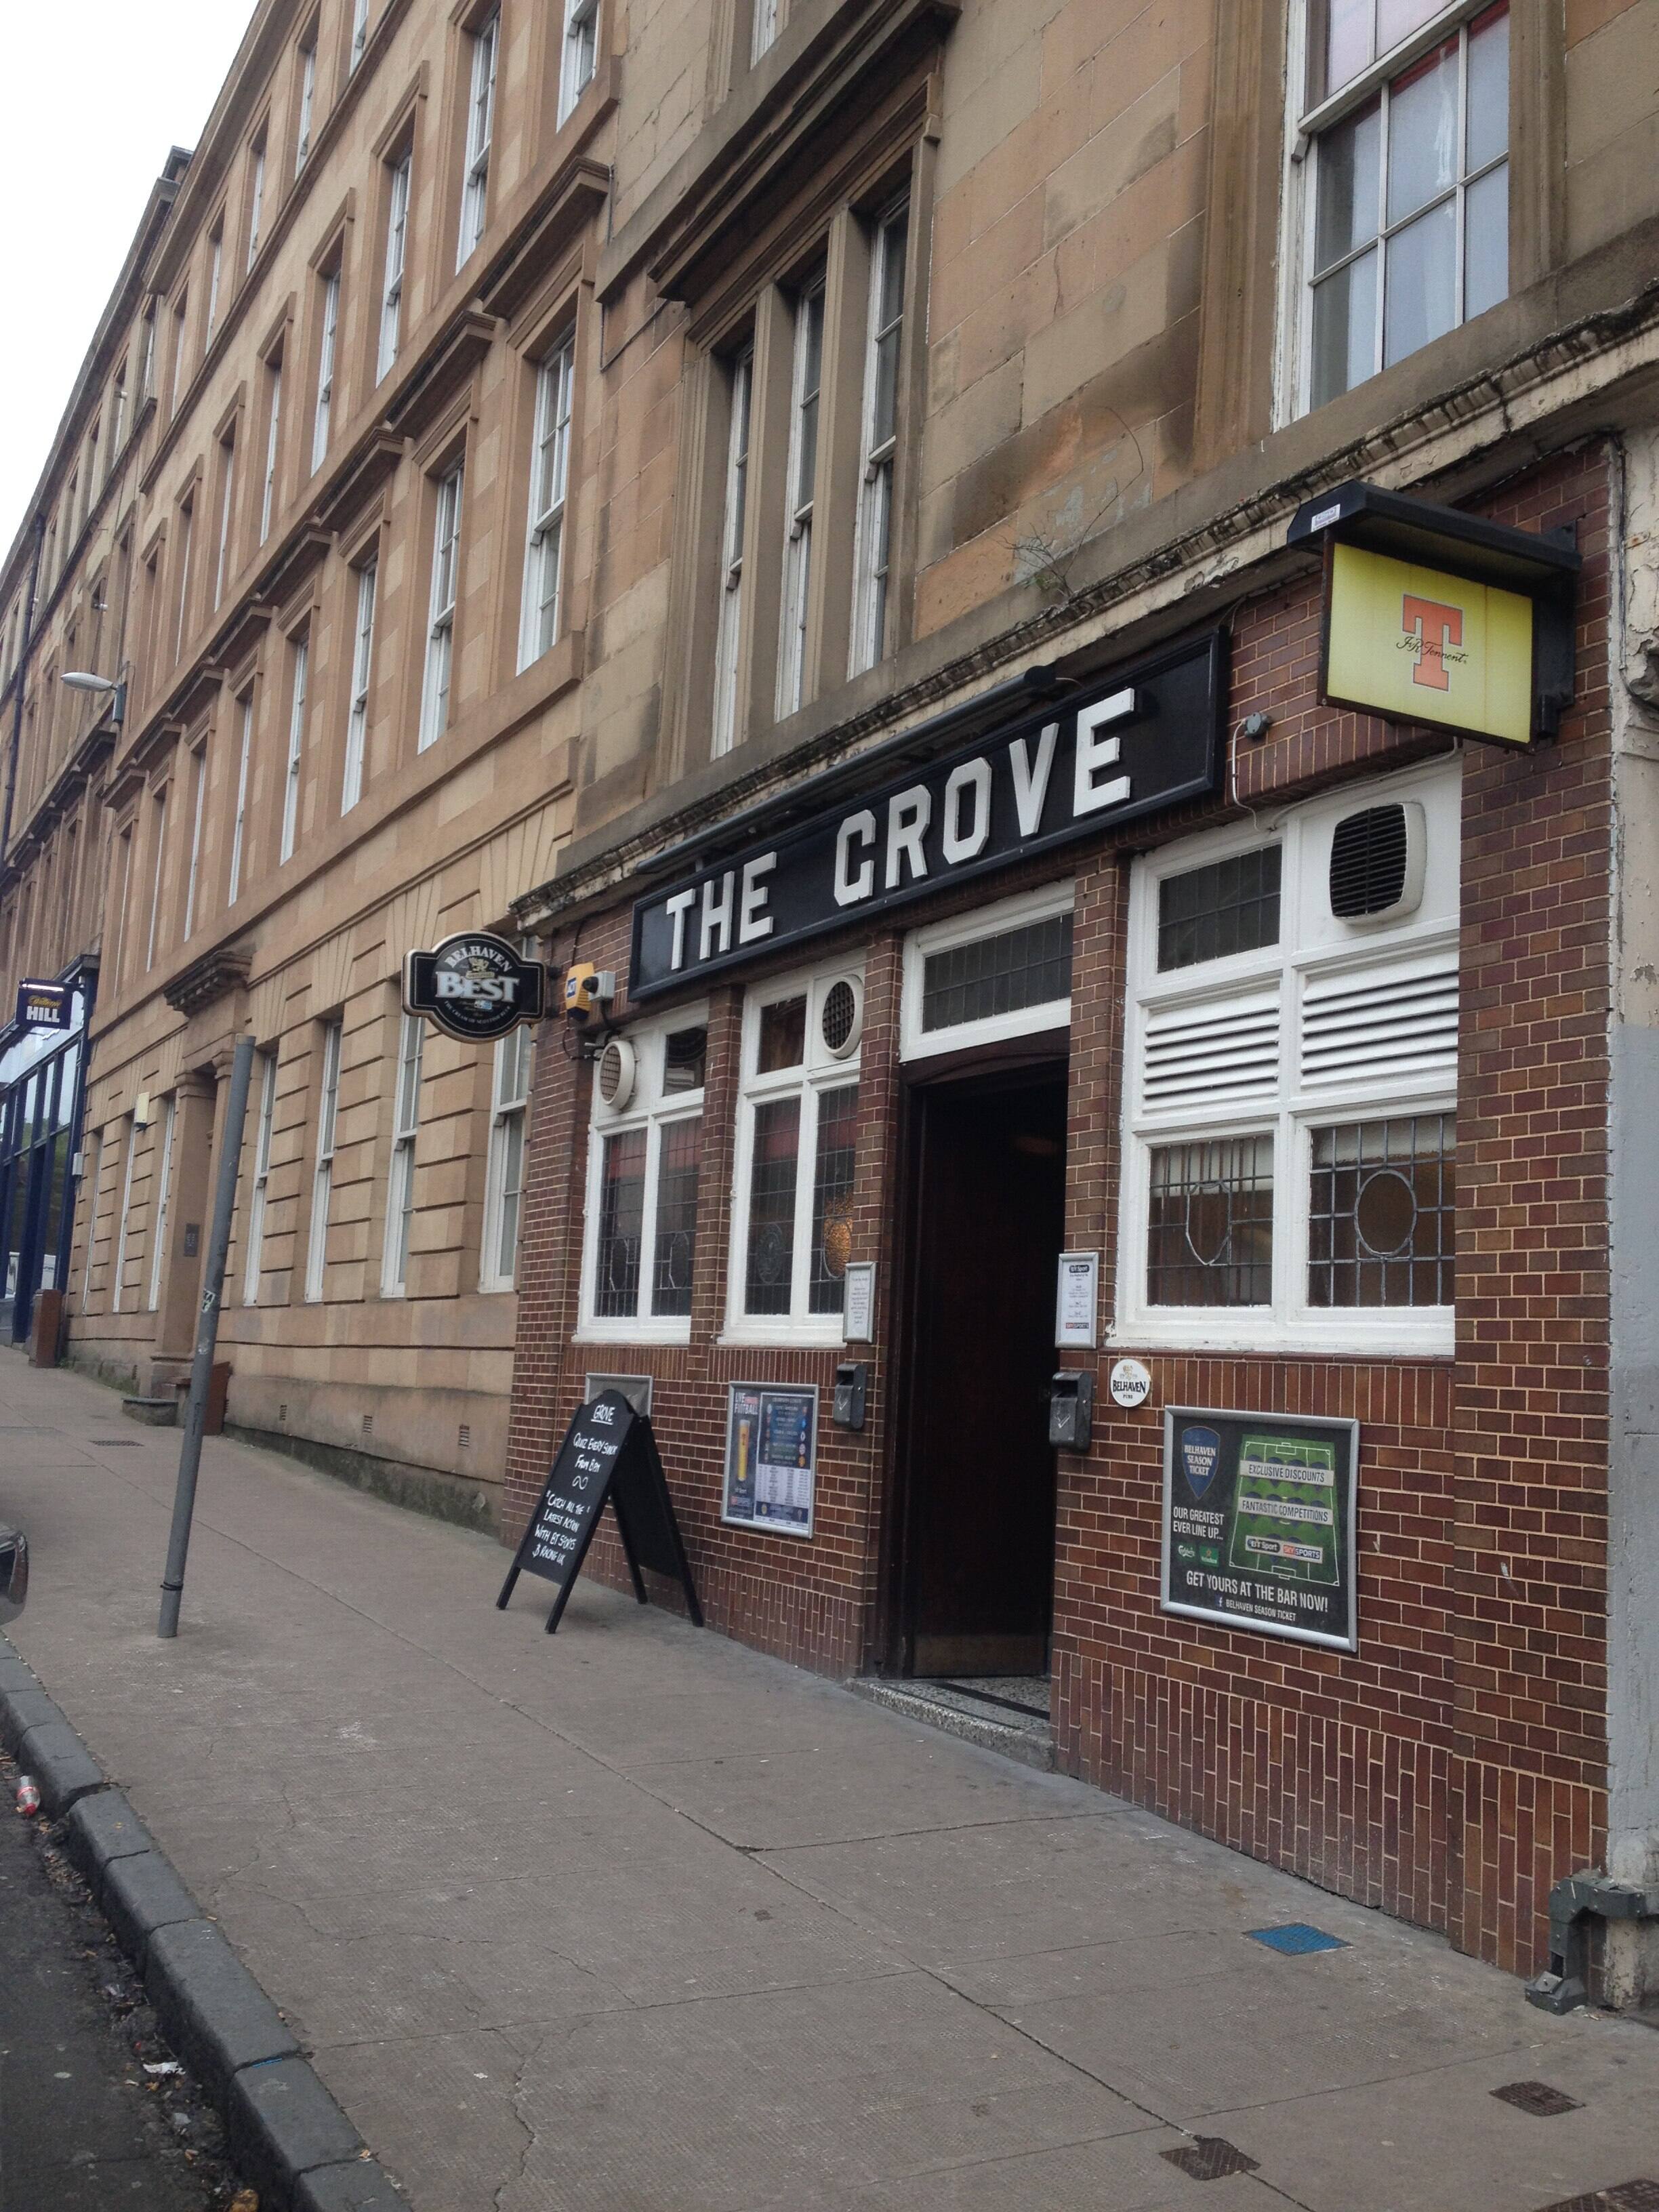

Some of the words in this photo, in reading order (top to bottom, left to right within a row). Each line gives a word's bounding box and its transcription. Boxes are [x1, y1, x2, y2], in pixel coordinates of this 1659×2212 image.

[666, 851, 777, 970] THE
[833, 687, 1135, 907] GROVE
[444, 945, 512, 972] BELHAVEN
[434, 970, 520, 1003] BEST
[26, 1005, 60, 1023] HILL
[1113, 1379, 1146, 1394] BELHAVEN
[593, 1404, 615, 1422] GROVE
[1184, 1444, 1216, 1457] BELHAVEN
[1187, 1454, 1213, 1467] SEASON
[1189, 1465, 1210, 1477] TICKET
[1248, 1464, 1284, 1478] EXCLUSIVE
[1285, 1469, 1325, 1483] DISCOUNTS
[1173, 1507, 1189, 1520] OUR
[1189, 1509, 1225, 1525] GREATEST
[1242, 1500, 1279, 1515] FANTASTIC
[1279, 1506, 1328, 1522] COMPETITIONS
[1173, 1520, 1191, 1534] EVER
[1191, 1523, 1206, 1538] LINE
[1294, 1548, 1320, 1559] SPORTS
[1187, 1570, 1205, 1587] GET
[1206, 1574, 1237, 1595] YOURS
[1240, 1581, 1252, 1597] AT
[1254, 1583, 1275, 1602] THE
[1277, 1588, 1298, 1607] BAR
[1299, 1593, 1328, 1613] NOW!
[1225, 1599, 1254, 1613] BELHAVEN
[1254, 1603, 1276, 1618] SEASON
[1277, 1610, 1296, 1622] TICKET
